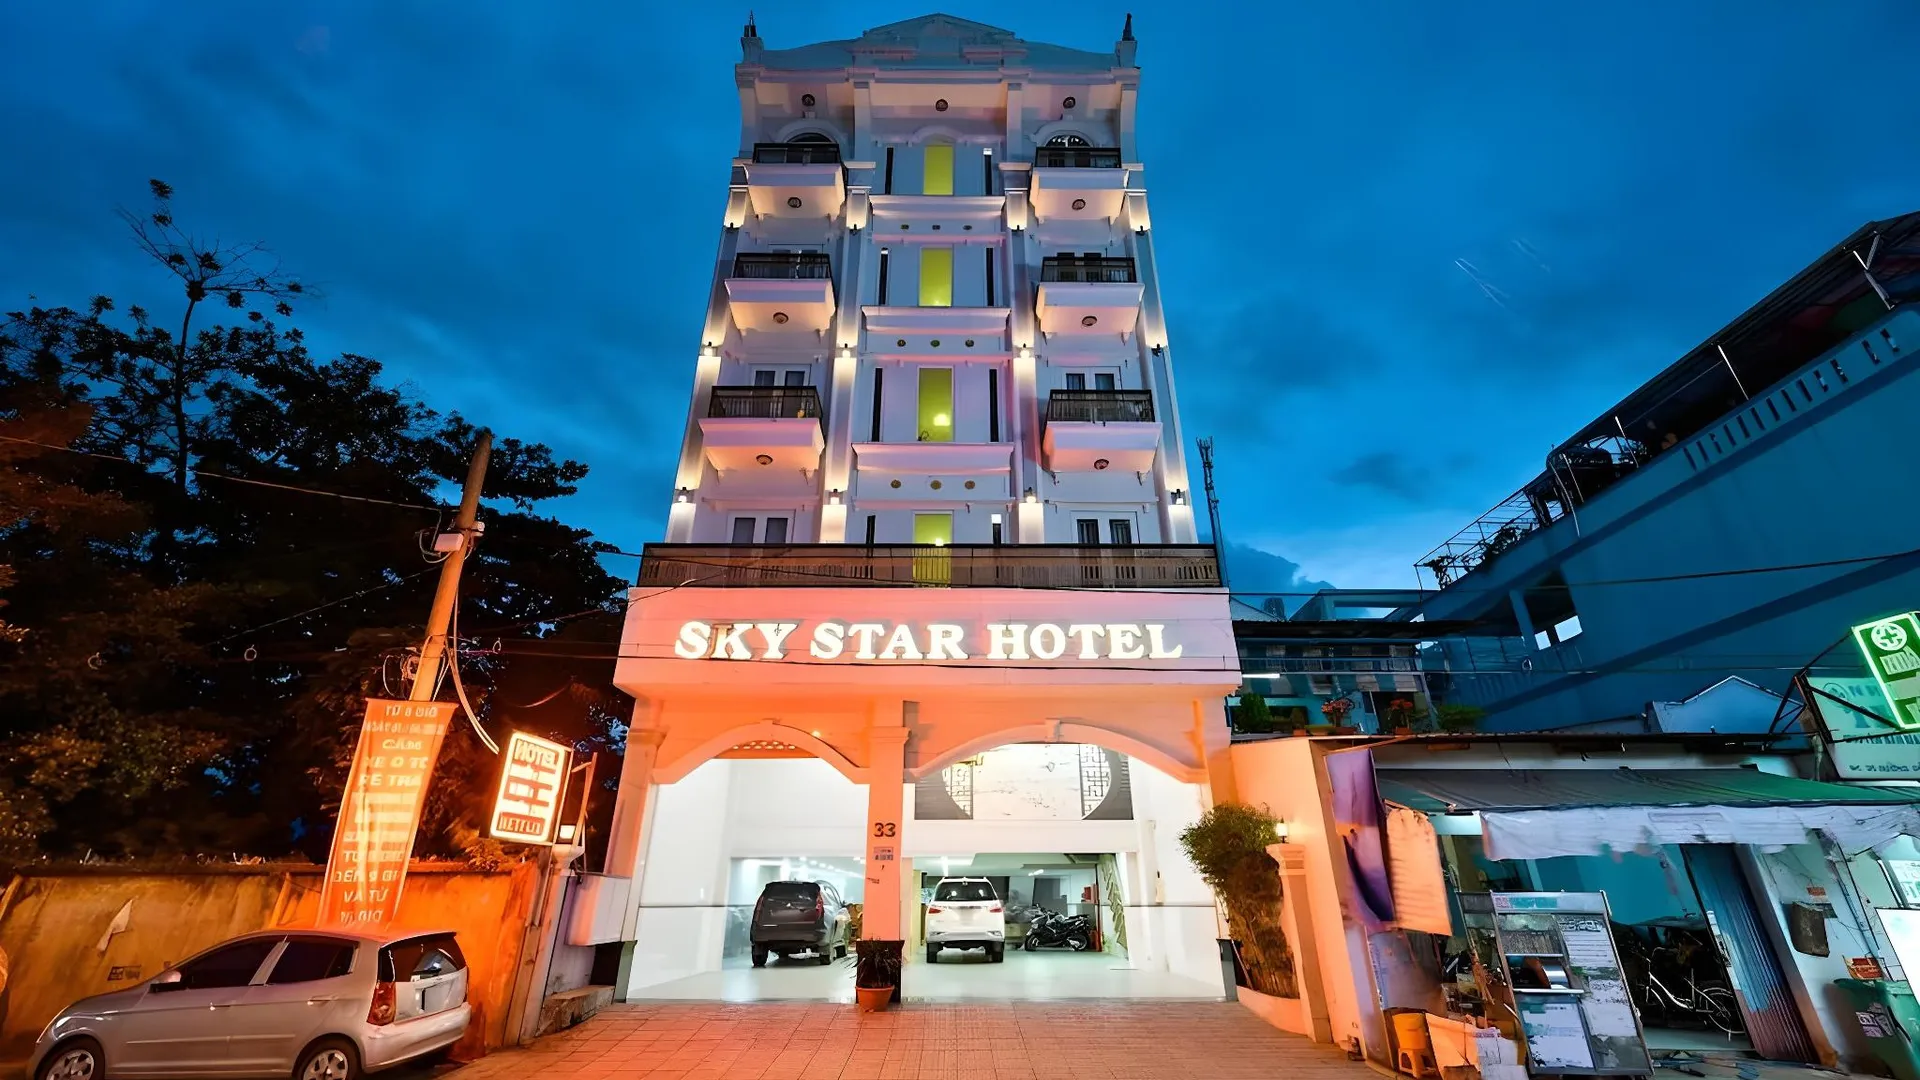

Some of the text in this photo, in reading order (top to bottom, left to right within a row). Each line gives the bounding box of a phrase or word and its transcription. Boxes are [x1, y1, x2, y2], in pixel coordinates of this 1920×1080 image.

[675, 621, 1183, 660] SKY STAR HOTEL
[873, 822, 896, 838] 33
